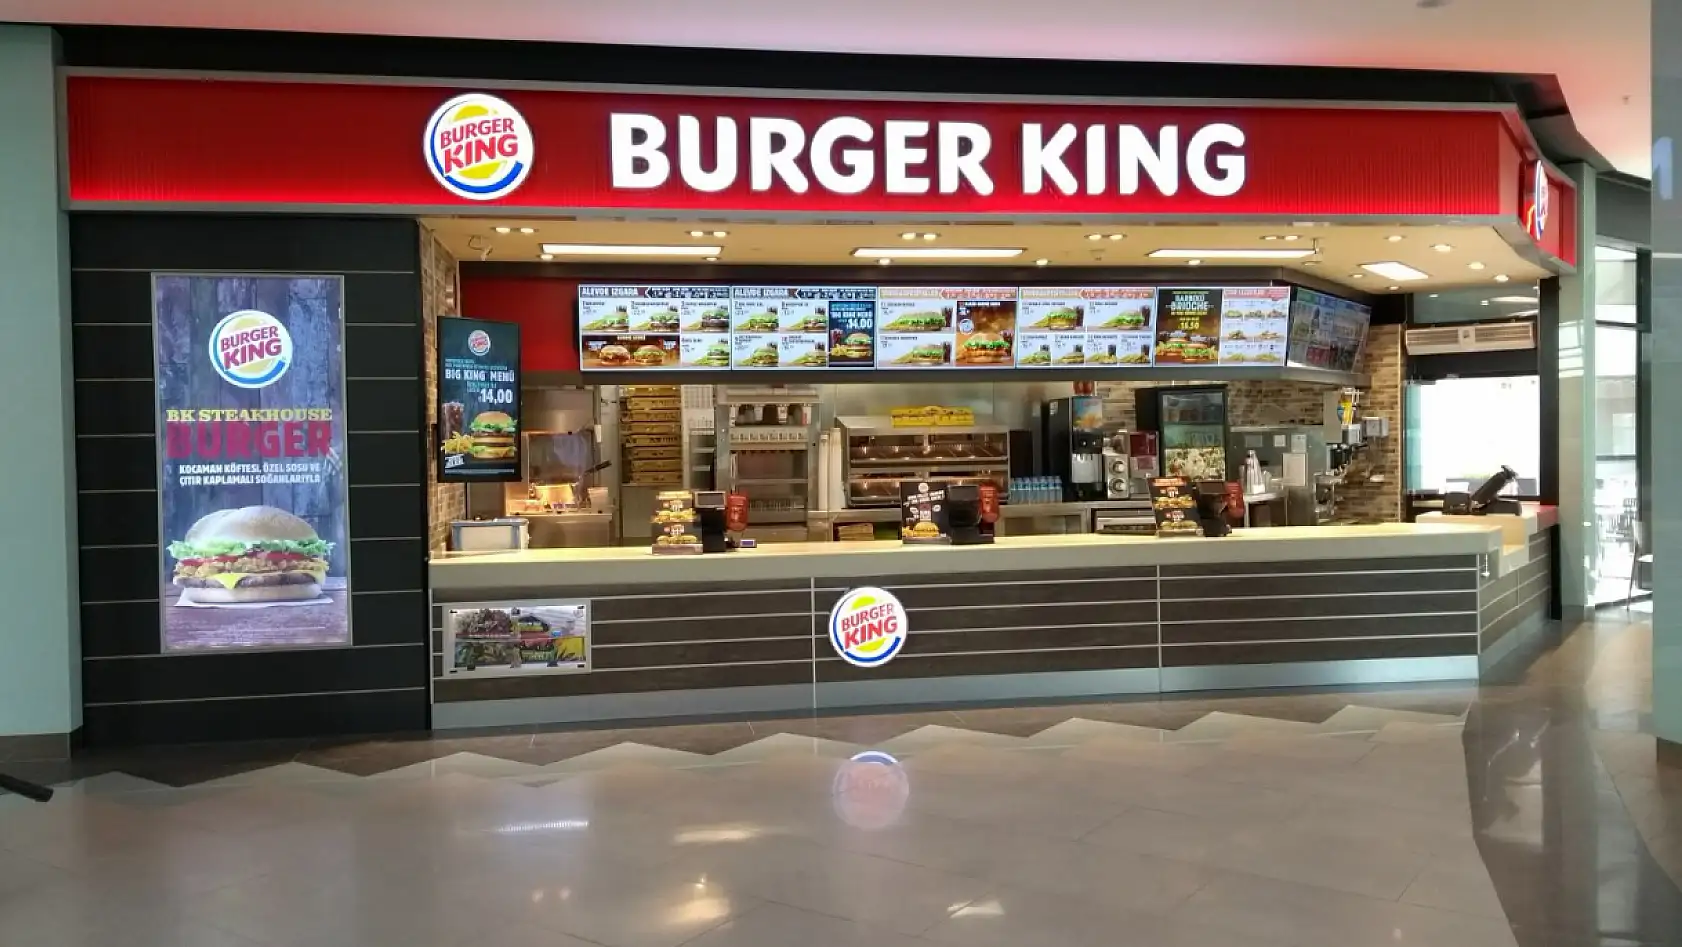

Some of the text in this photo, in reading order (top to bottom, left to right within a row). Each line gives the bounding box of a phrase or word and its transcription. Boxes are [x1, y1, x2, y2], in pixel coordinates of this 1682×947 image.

[440, 118, 515, 150] BURGER
[444, 133, 519, 174] KING
[609, 112, 1247, 197] BURGER KING
[220, 325, 279, 353] BURGER
[223, 338, 282, 370] KING
[445, 369, 461, 380] BIG
[463, 370, 486, 381] KING
[166, 408, 333, 422] BK STEAKHOUSE
[166, 421, 333, 459] BURGER
[179, 463, 223, 474] KOCAMAN
[263, 462, 284, 473] ÖZEL
[285, 463, 309, 472] SOSU
[310, 463, 321, 472] VE
[841, 603, 895, 632] BURGER
[844, 616, 898, 649] KING
